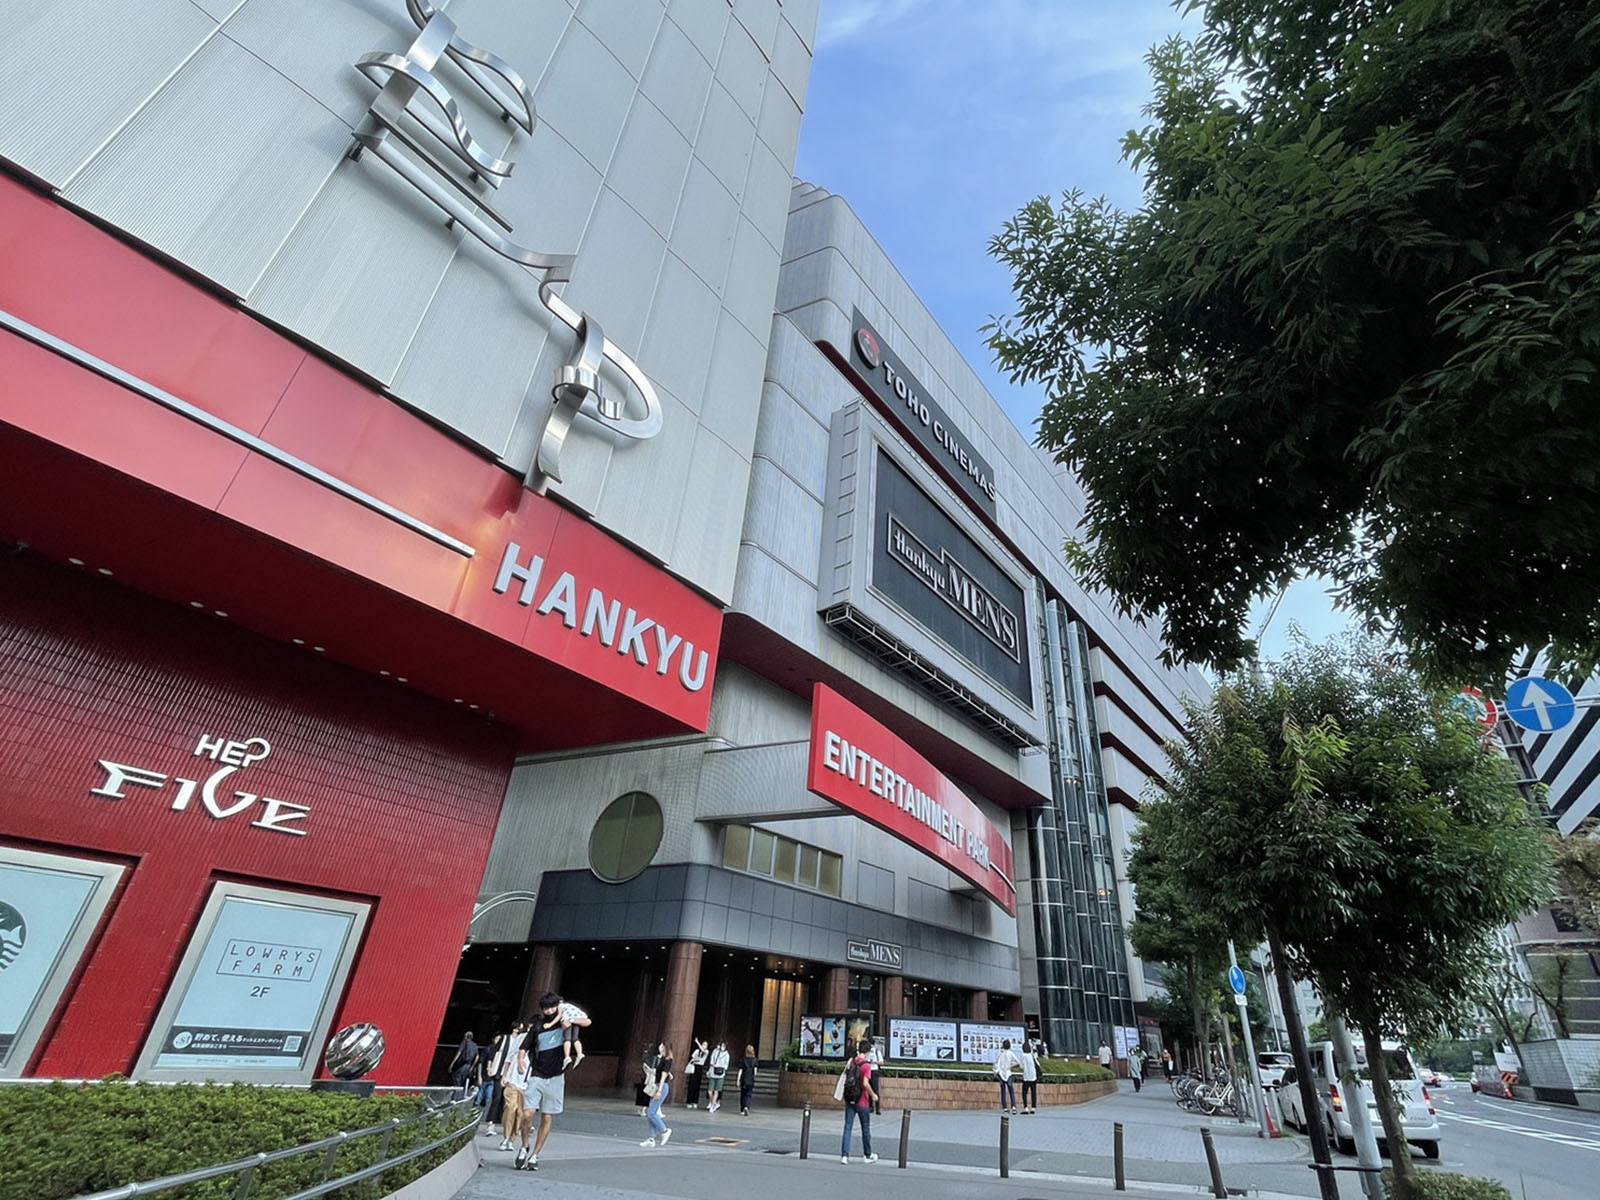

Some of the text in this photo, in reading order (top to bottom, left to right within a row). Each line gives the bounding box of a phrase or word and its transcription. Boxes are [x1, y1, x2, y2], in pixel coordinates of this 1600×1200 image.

[881, 361, 996, 502] TOHO CINEMAS
[894, 529, 1015, 649] Hankyu MENS
[493, 541, 708, 691] HANKYU
[194, 734, 271, 767] HEP
[824, 730, 990, 870] ENTERTAINMENT PARK
[230, 944, 315, 963] LOWRYS
[232, 960, 303, 976] FARM
[870, 944, 900, 964] MENS
[250, 986, 270, 998] 2F
